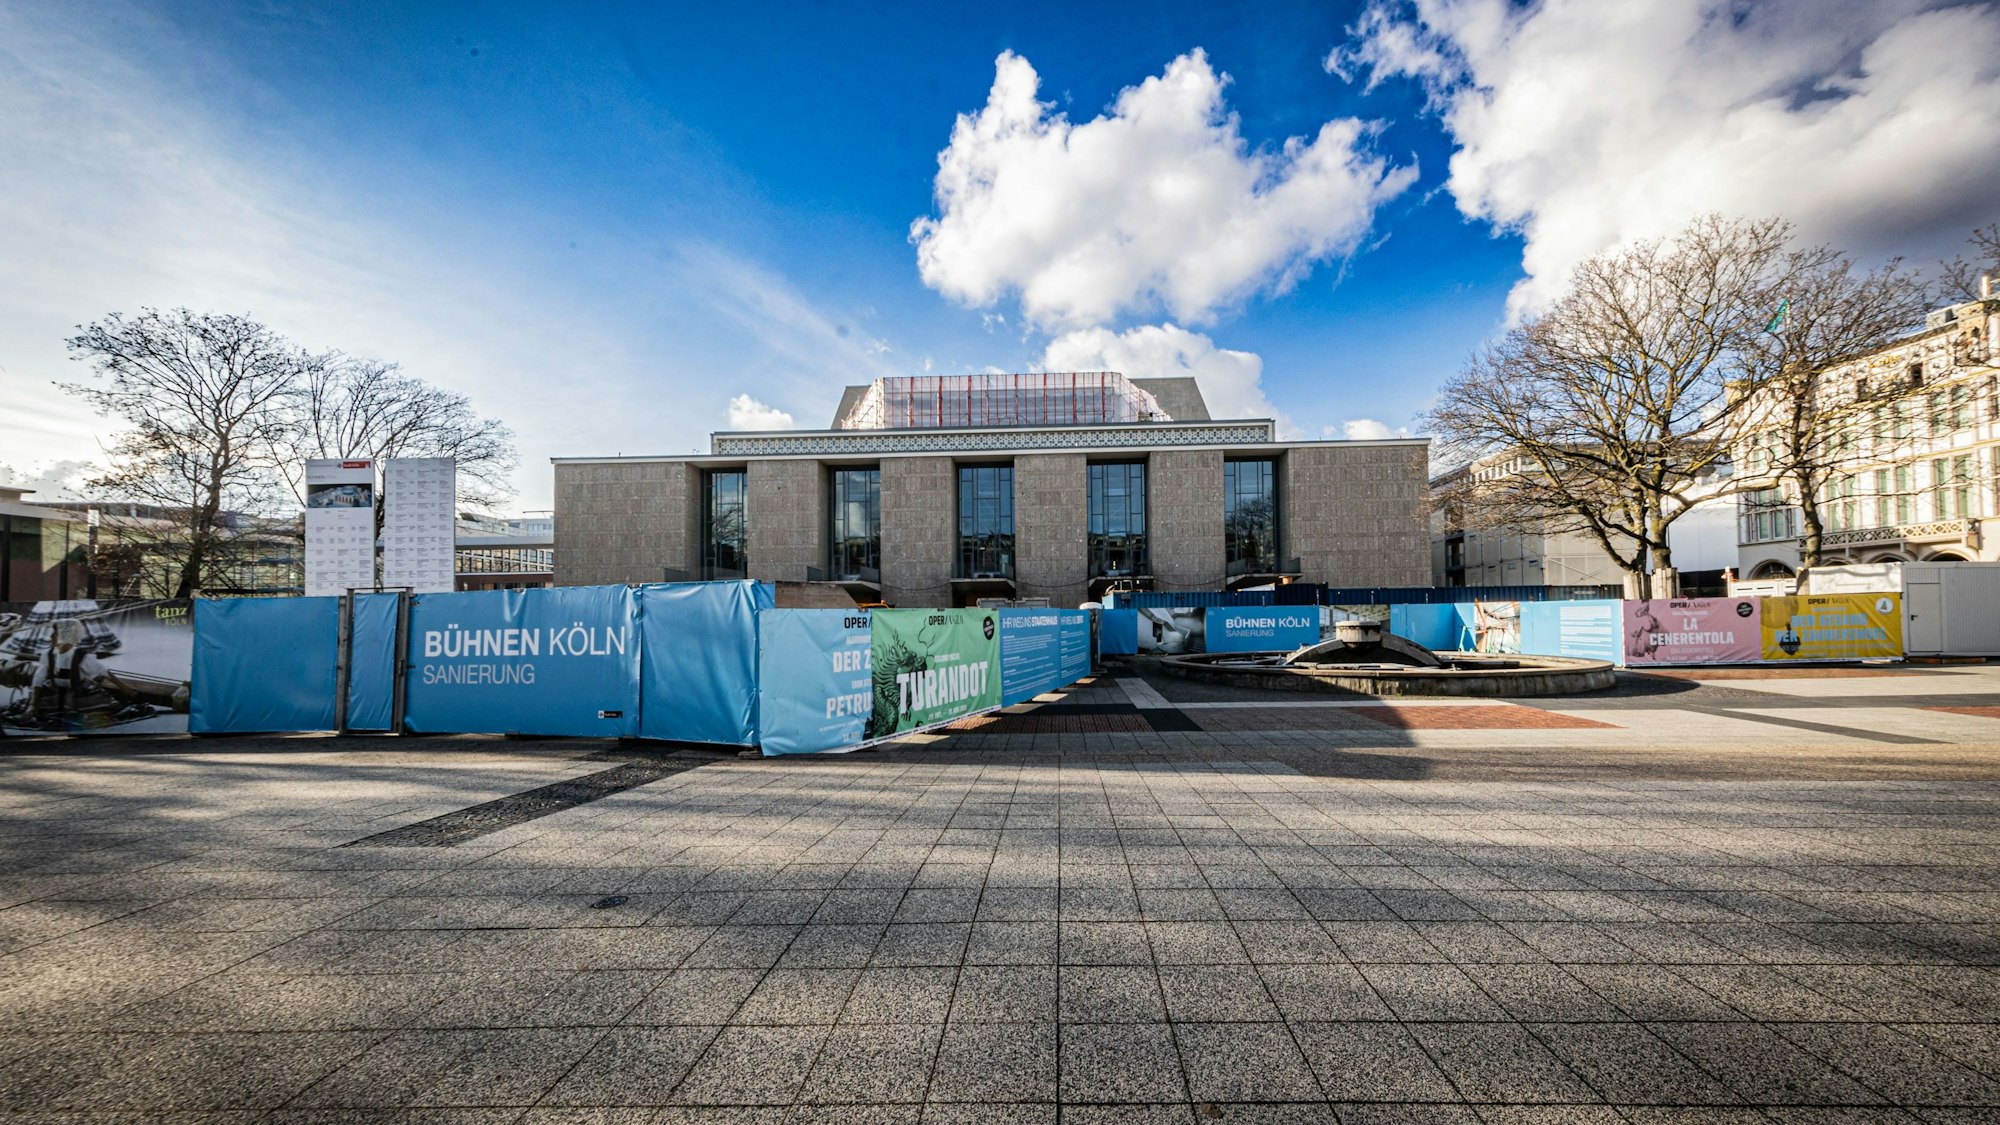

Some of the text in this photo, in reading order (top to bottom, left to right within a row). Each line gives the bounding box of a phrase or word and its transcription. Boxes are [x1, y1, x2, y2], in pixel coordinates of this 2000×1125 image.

[154, 605, 187, 620] tanz
[1791, 613, 1869, 627] DER GESANG
[1225, 616, 1310, 628] BÜHNEN KÖLN
[1683, 618, 1698, 631] LA
[424, 621, 626, 658] BÜHNEN KÖLN
[1225, 629, 1274, 638] SANIERUNG
[1649, 631, 1734, 646] CENERENTOLA
[1775, 629, 1798, 642] DER
[833, 650, 861, 673] DER
[423, 663, 535, 685] SANIERUNG
[896, 661, 988, 715] TURANDOT
